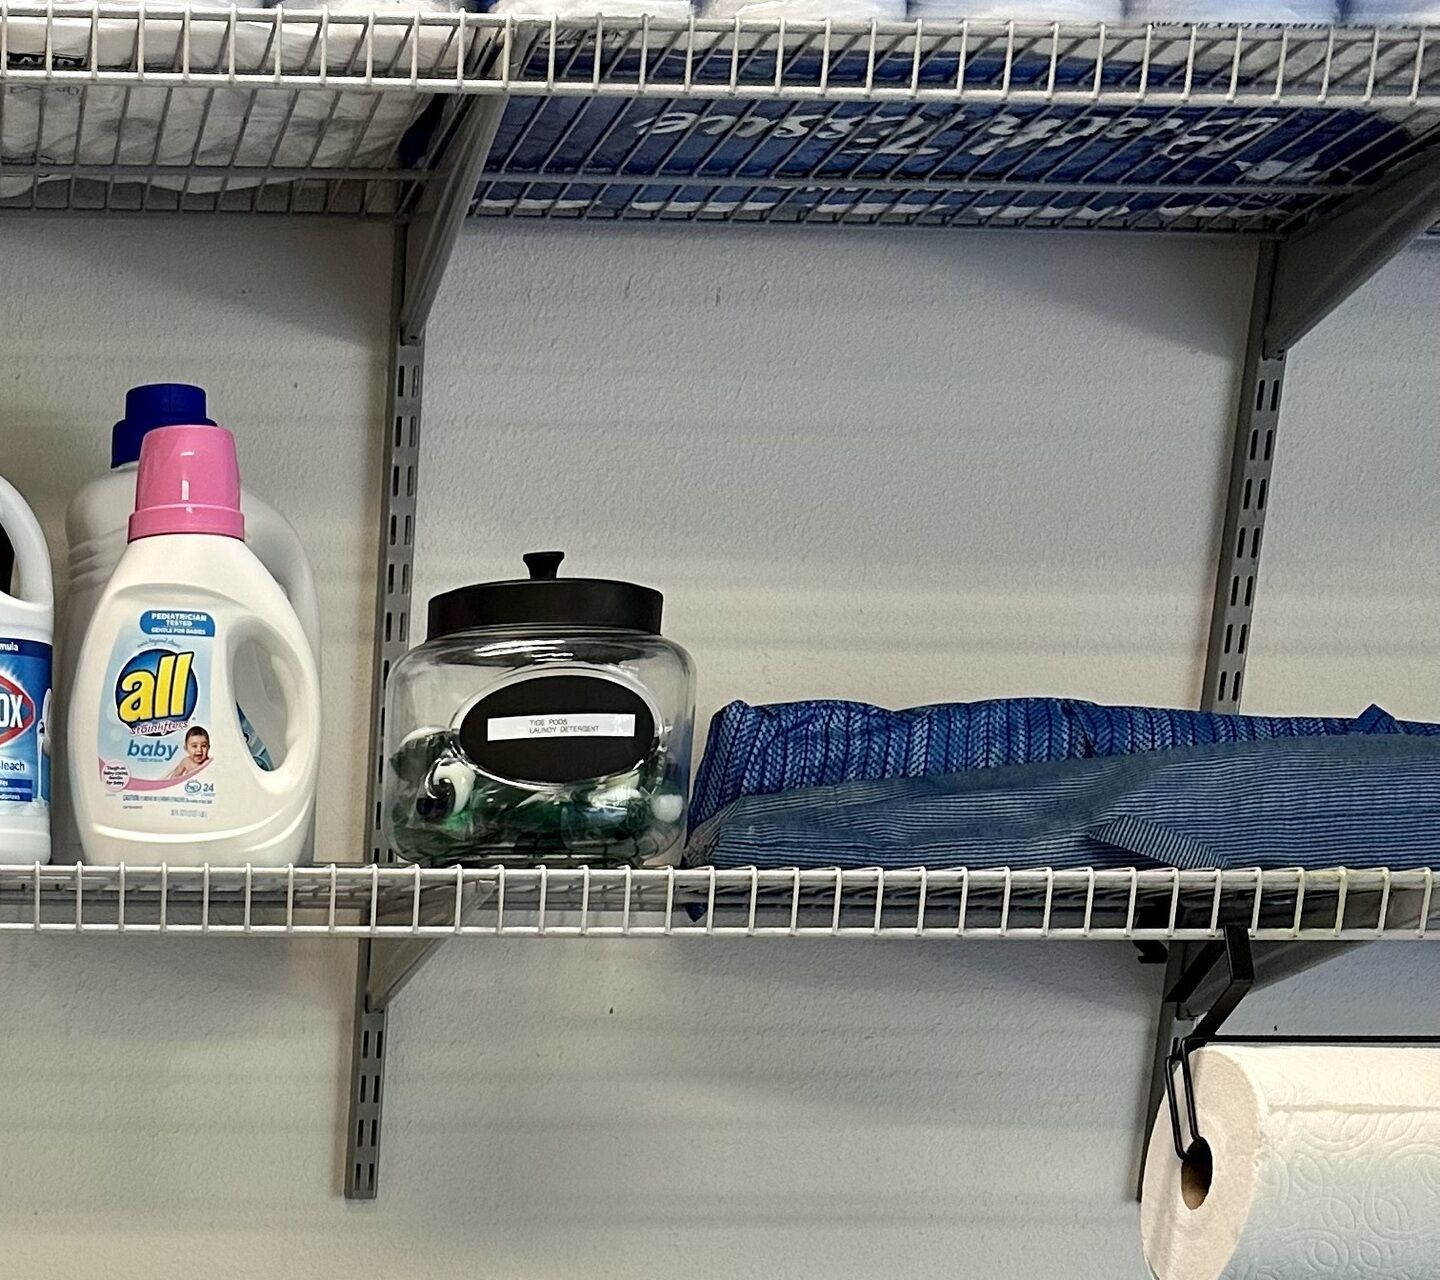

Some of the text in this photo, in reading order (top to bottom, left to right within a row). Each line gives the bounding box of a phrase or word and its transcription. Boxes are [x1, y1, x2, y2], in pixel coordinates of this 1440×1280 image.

[151, 612, 207, 621] PEDIATRICIAN
[118, 651, 195, 724] all
[559, 725, 600, 733] DETERGENT
[126, 739, 179, 762] baby
[202, 783, 215, 792] 24
